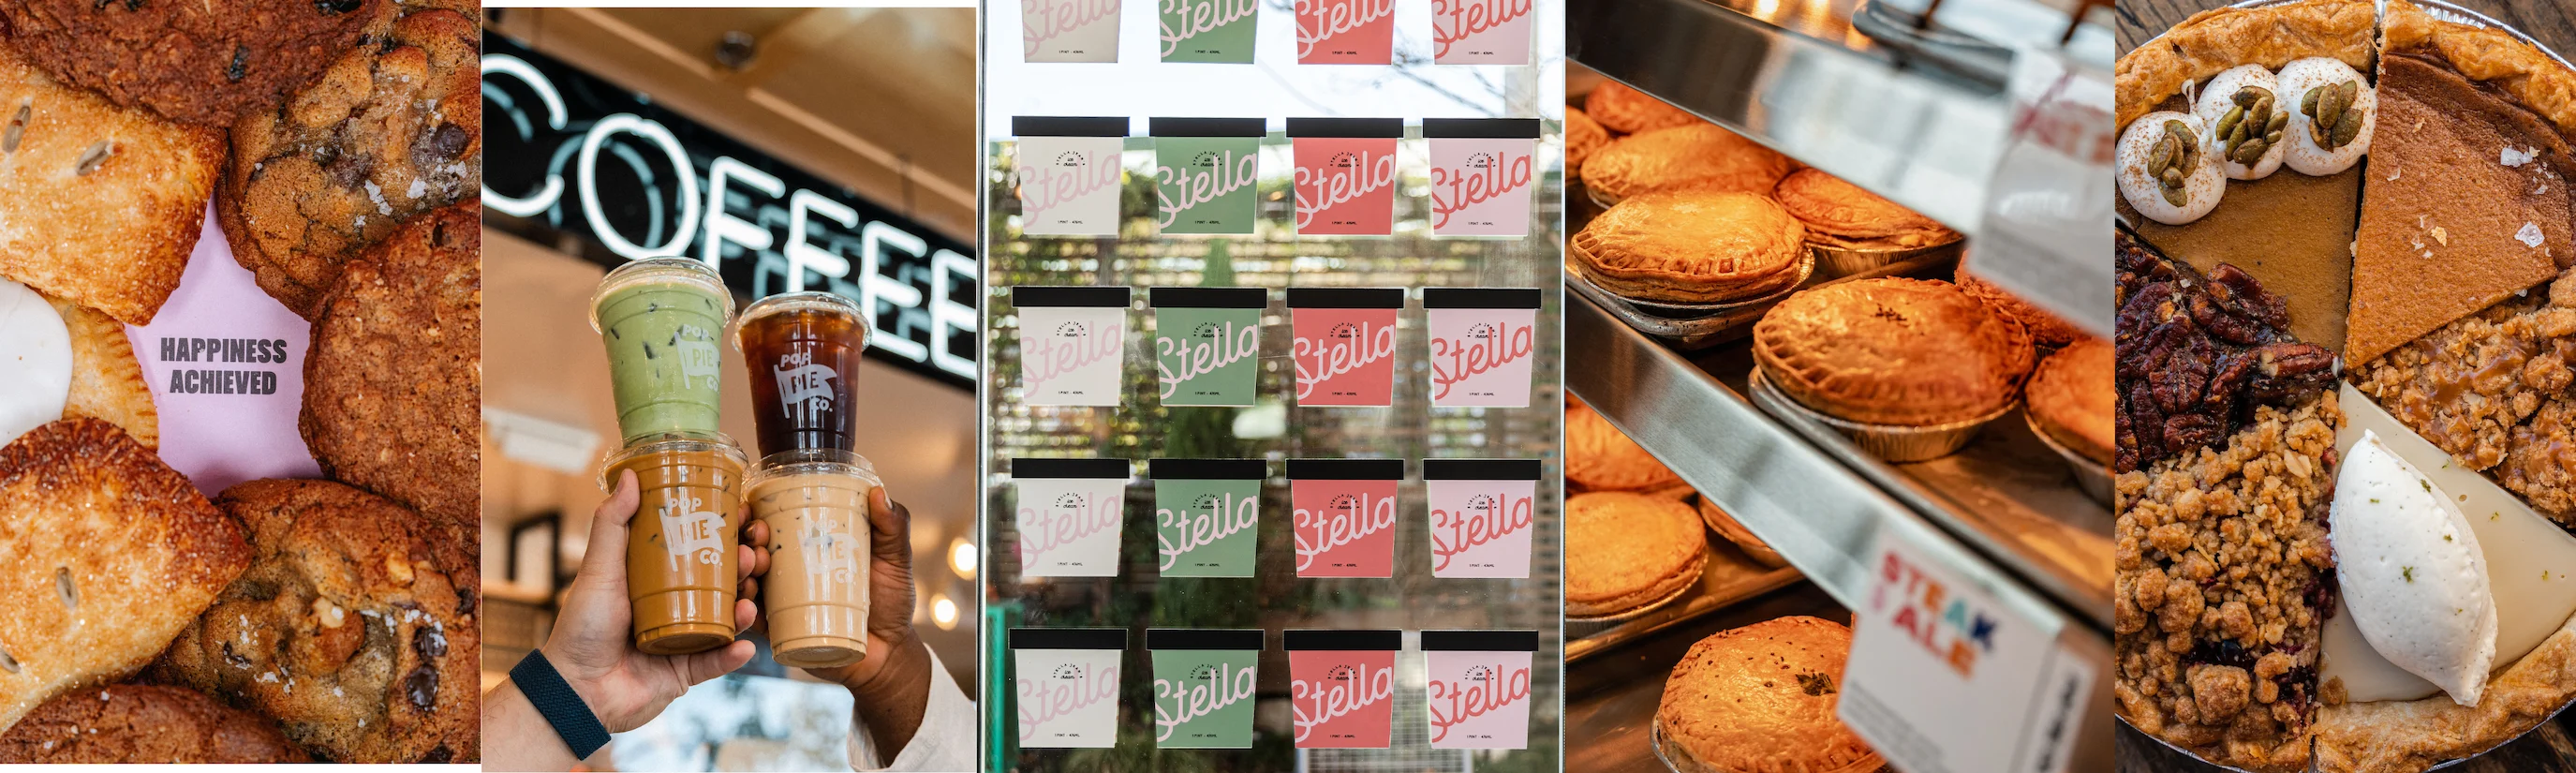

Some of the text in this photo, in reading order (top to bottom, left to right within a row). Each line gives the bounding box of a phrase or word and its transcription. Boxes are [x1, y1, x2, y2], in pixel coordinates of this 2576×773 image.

[481, 53, 976, 380] COFFEE
[1020, 150, 1121, 229] Stella
[1156, 150, 1258, 229] Stella
[1294, 151, 1395, 230] Stella
[1430, 152, 1531, 230] Stella
[161, 337, 287, 364] HAPPINESS
[682, 324, 709, 339] POP
[692, 348, 714, 367] PIE
[780, 352, 811, 367] POP
[1021, 320, 1122, 399] Stella
[1157, 321, 1258, 400] Stella
[1294, 321, 1395, 400] Stella
[1431, 322, 1532, 401] Stella
[170, 370, 277, 395] ACHIEVED
[791, 372, 819, 394] PIE
[669, 498, 702, 512] POP
[808, 519, 837, 532] POP
[1020, 492, 1121, 571] Stella
[1156, 493, 1258, 572] Stella
[1294, 493, 1395, 572] Stella
[1431, 493, 1532, 572] Stella
[1881, 550, 1997, 654] STEAK
[1891, 603, 1976, 682] ALE
[1017, 662, 1118, 741] Stella
[1154, 663, 1255, 742] Stella
[1291, 663, 1392, 742] Stella
[1428, 664, 1529, 743] Stella
